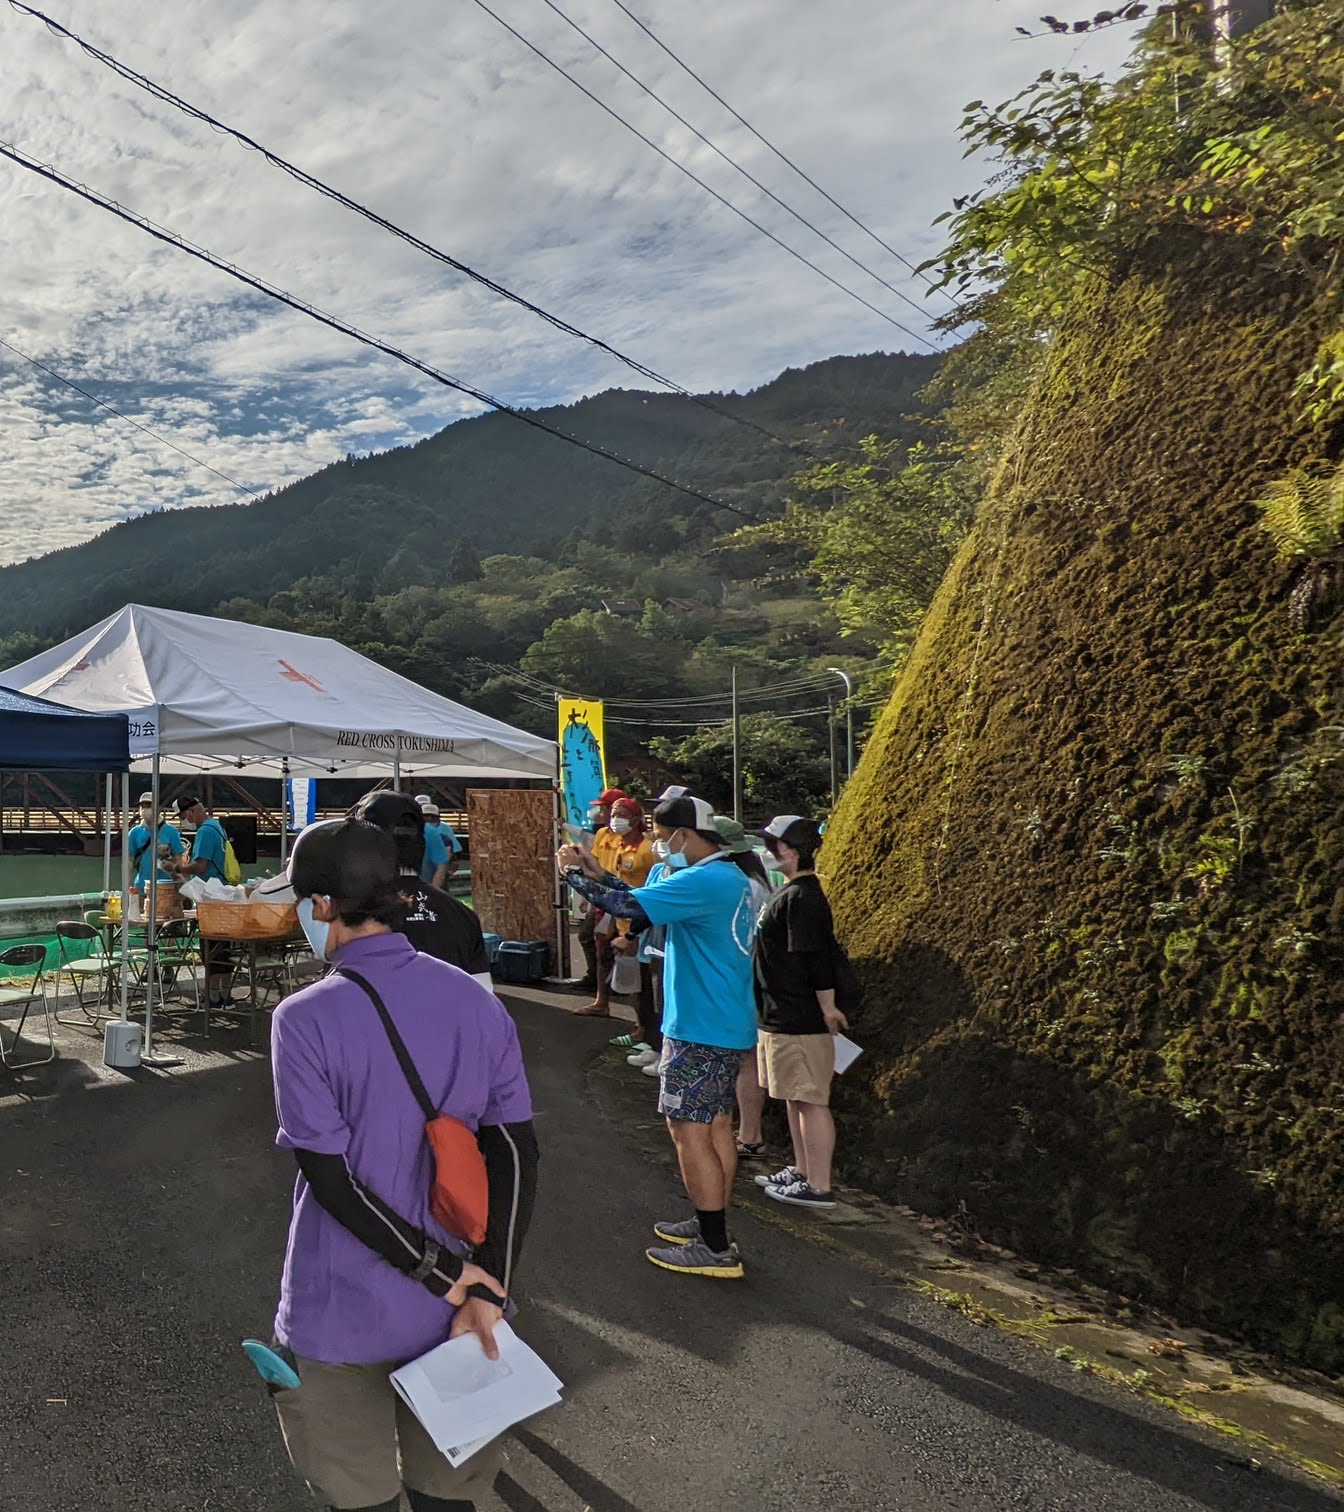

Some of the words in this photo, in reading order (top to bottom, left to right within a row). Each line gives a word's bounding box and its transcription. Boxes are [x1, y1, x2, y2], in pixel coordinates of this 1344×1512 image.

[337, 730, 360, 746] RED
[362, 733, 396, 749] CROSS
[398, 736, 455, 752] TOKUSHIMA
